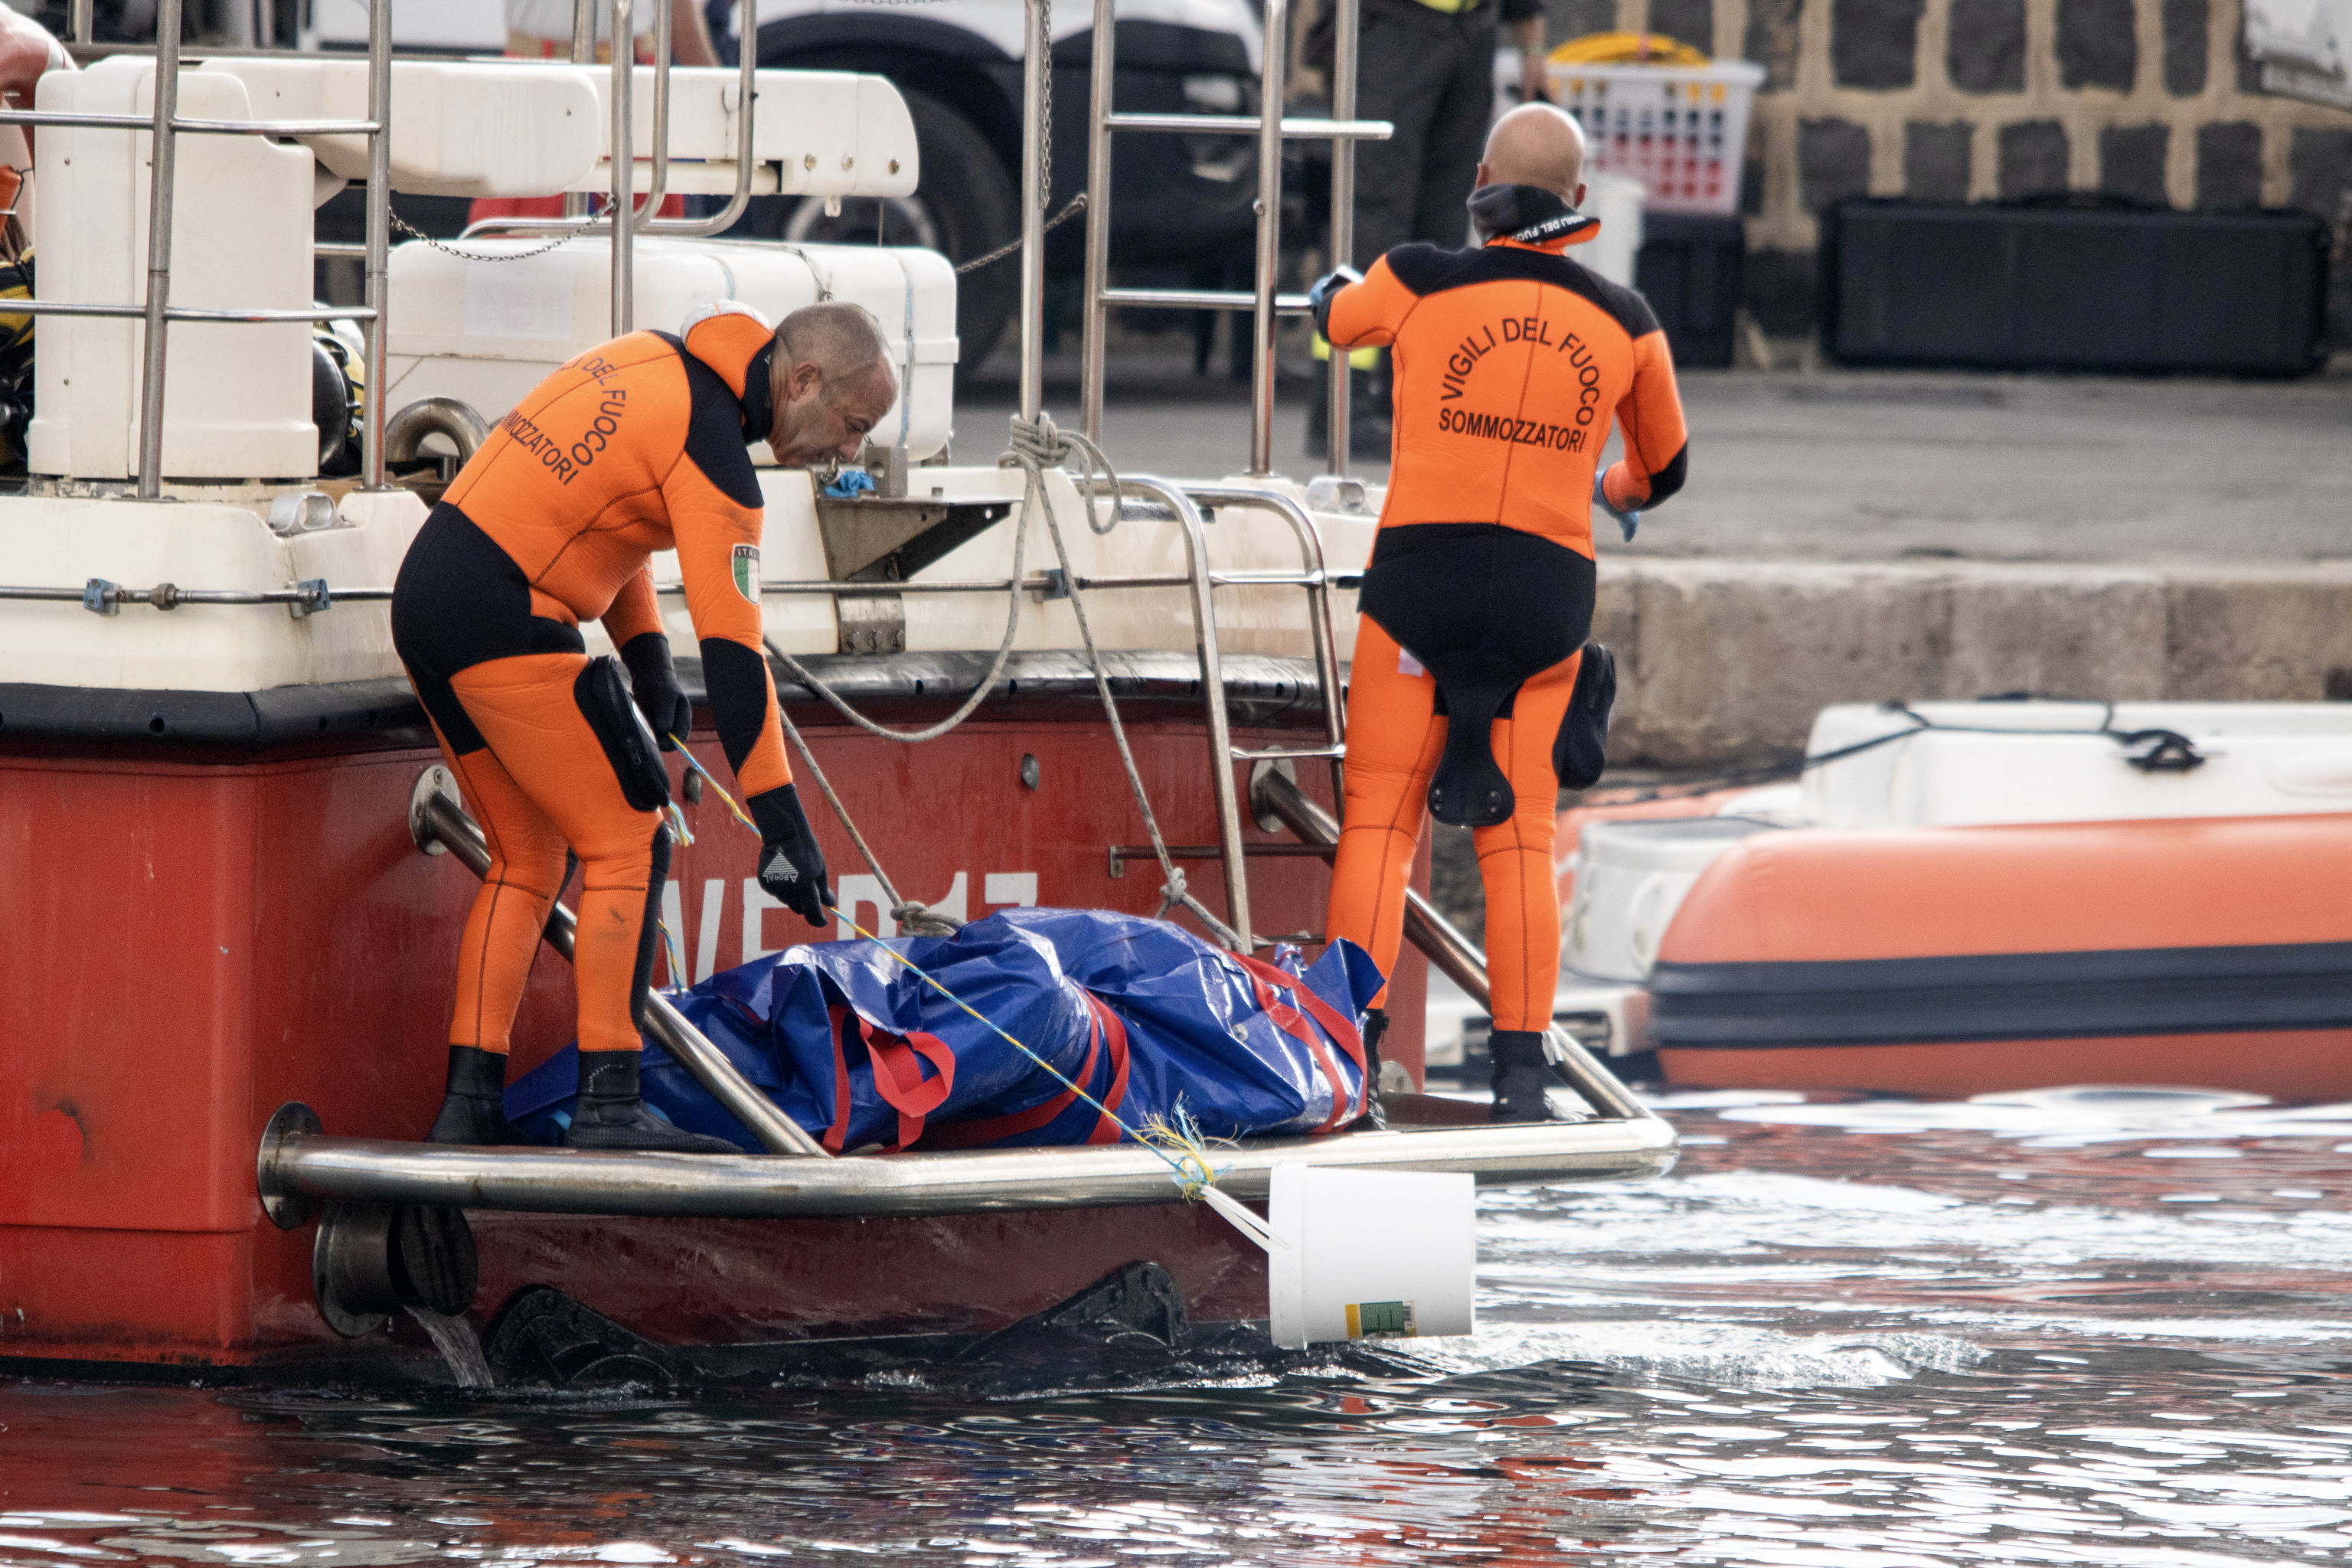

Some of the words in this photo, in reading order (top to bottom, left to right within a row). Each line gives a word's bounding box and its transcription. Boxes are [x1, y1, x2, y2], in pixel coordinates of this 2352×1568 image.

[1540, 220, 1560, 233] DEL
[582, 357, 619, 386] DEL
[1440, 325, 1497, 401] VIGILI
[1501, 318, 1552, 347] DEL
[1557, 332, 1600, 426] FUOCO
[571, 390, 626, 466] FUOCO
[1439, 407, 1587, 453] SOMMOZZATORI
